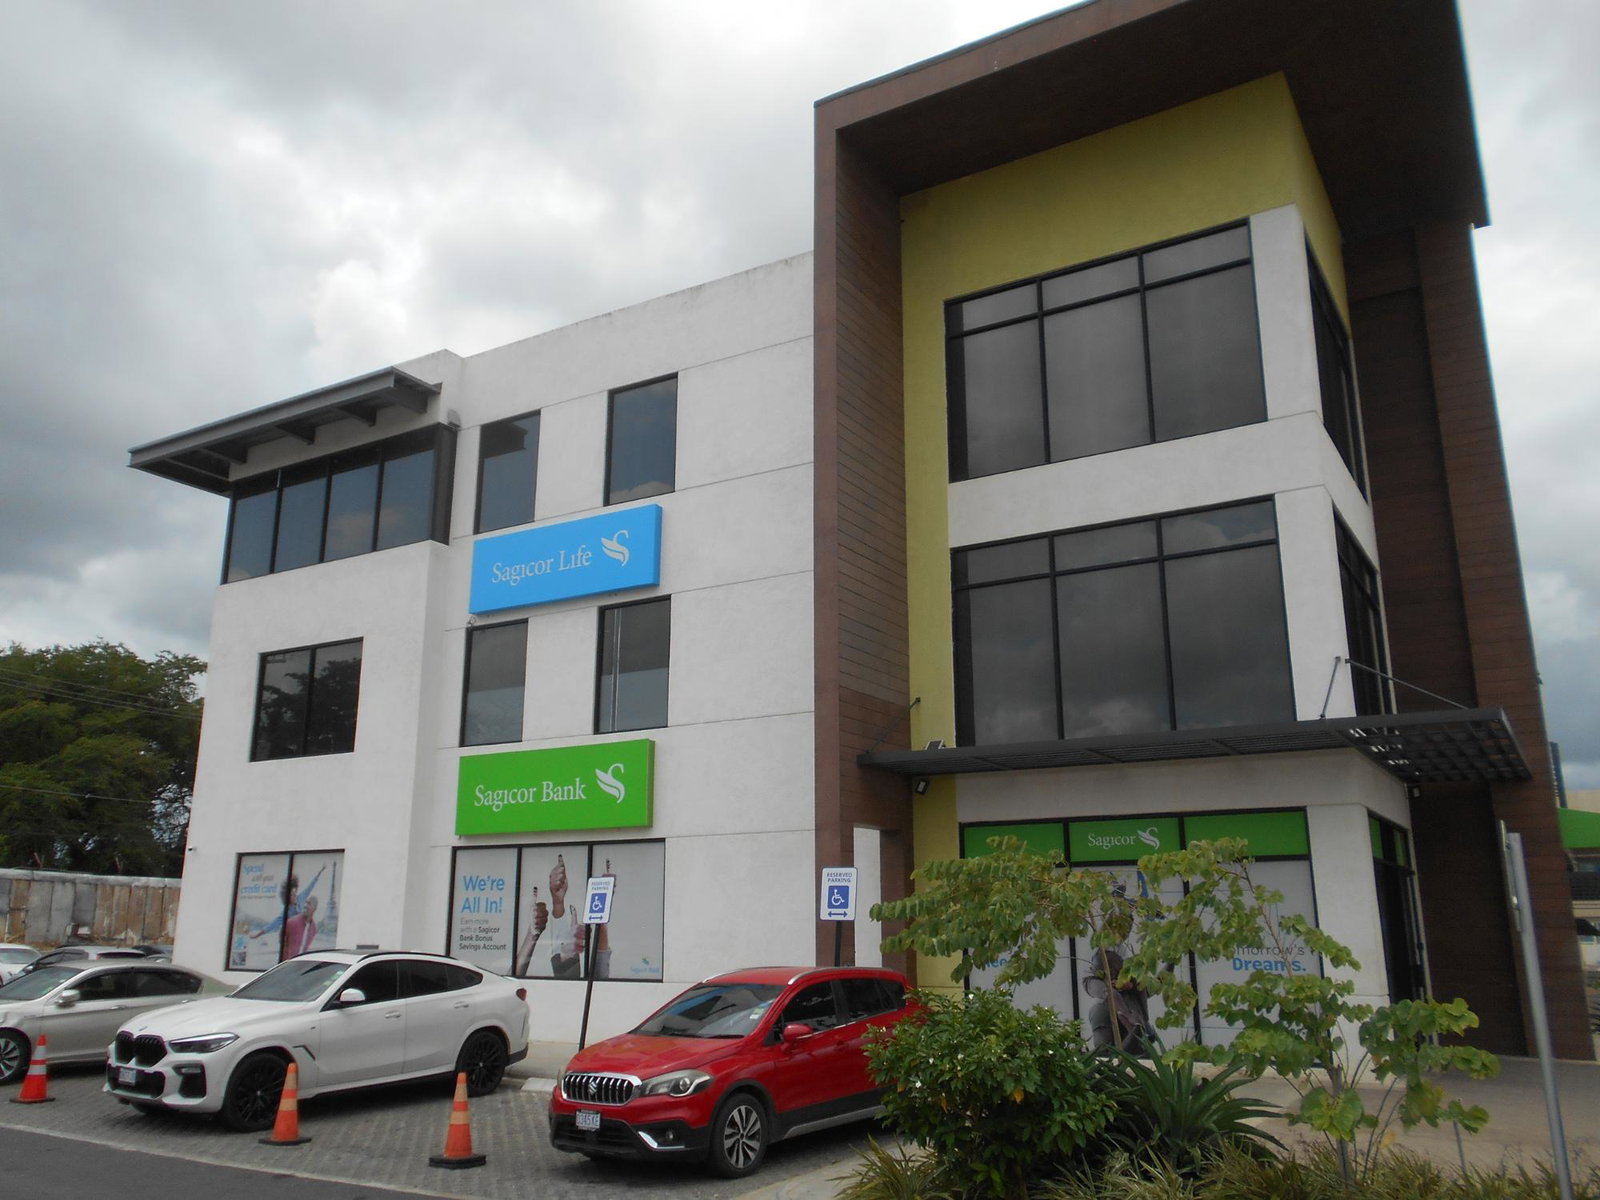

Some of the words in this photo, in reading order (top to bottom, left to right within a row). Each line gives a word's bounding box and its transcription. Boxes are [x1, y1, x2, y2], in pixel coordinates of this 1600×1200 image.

[491, 556, 554, 585] Sagicor
[559, 545, 593, 571] Life
[474, 783, 536, 812] Sagicor
[541, 777, 587, 803] Bank
[1087, 832, 1136, 850] Sagicor
[463, 875, 505, 891] We're
[461, 897, 480, 913] All
[485, 897, 504, 913] In!
[478, 926, 500, 934] Sagicor
[459, 943, 481, 951] Savings
[482, 943, 507, 951] Account
[1232, 957, 1306, 971] Dreams.
